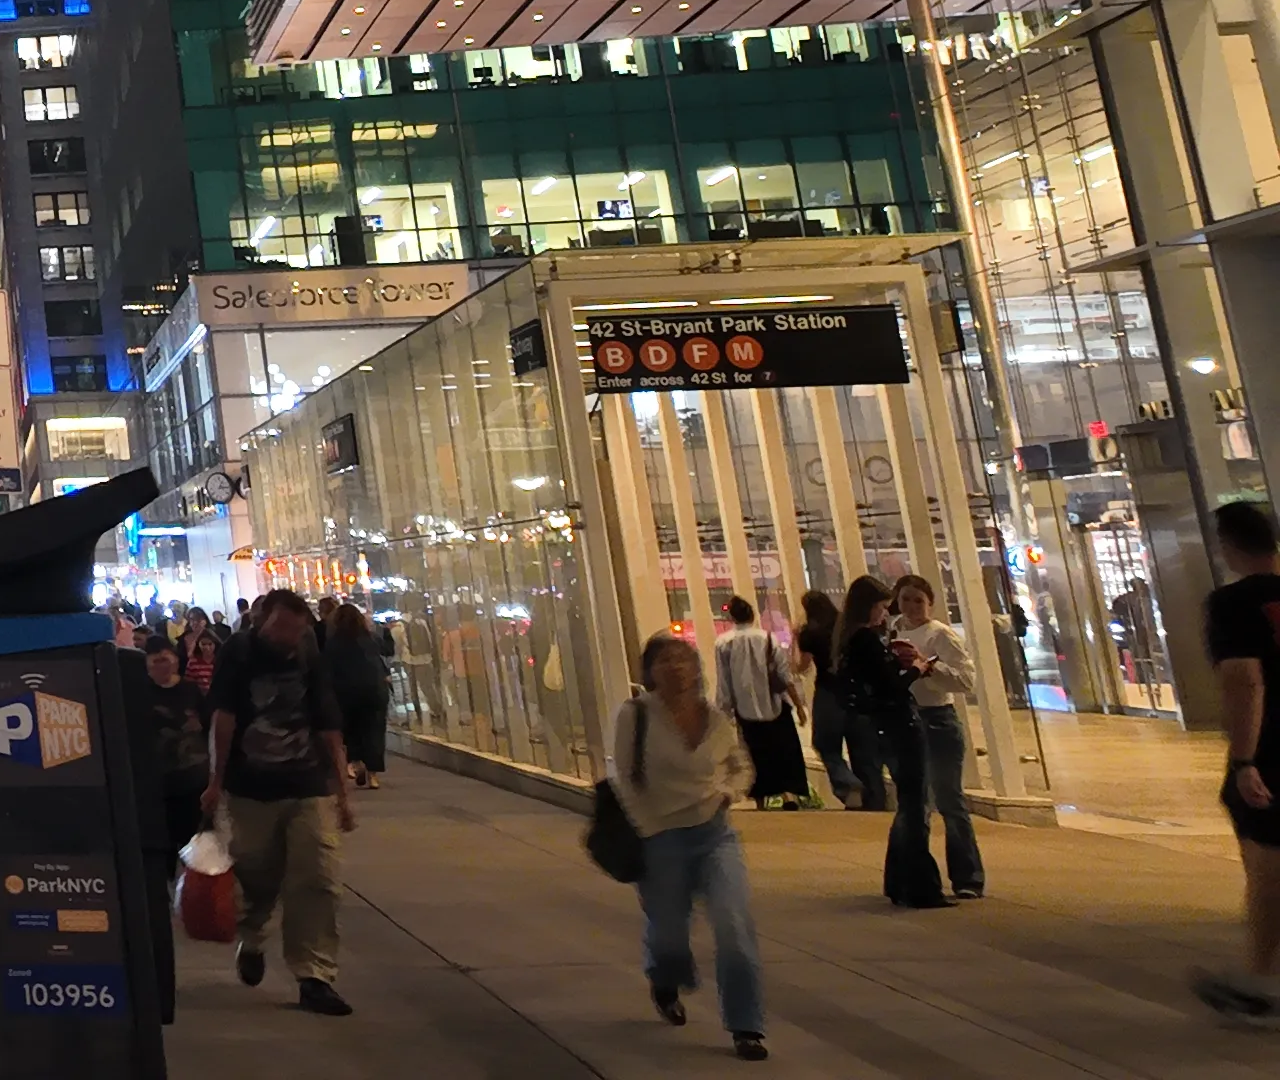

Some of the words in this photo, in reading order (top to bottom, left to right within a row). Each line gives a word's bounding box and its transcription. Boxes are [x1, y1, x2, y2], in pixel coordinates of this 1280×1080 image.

[589, 322, 615, 338] 42
[621, 320, 713, 339] St-Bryant
[721, 316, 766, 333] Park
[775, 313, 847, 331] Station
[605, 347, 625, 368] B
[648, 345, 668, 366] D
[692, 343, 709, 364] F
[733, 341, 755, 362] M
[598, 376, 632, 388] Enter
[640, 375, 684, 386] across
[691, 373, 710, 384] 42
[712, 371, 727, 384] St
[733, 371, 753, 383] for
[40, 698, 84, 726] PARK
[43, 727, 88, 761] NYC
[27, 877, 106, 894] ParkNYC
[23, 982, 115, 1009] 103956
